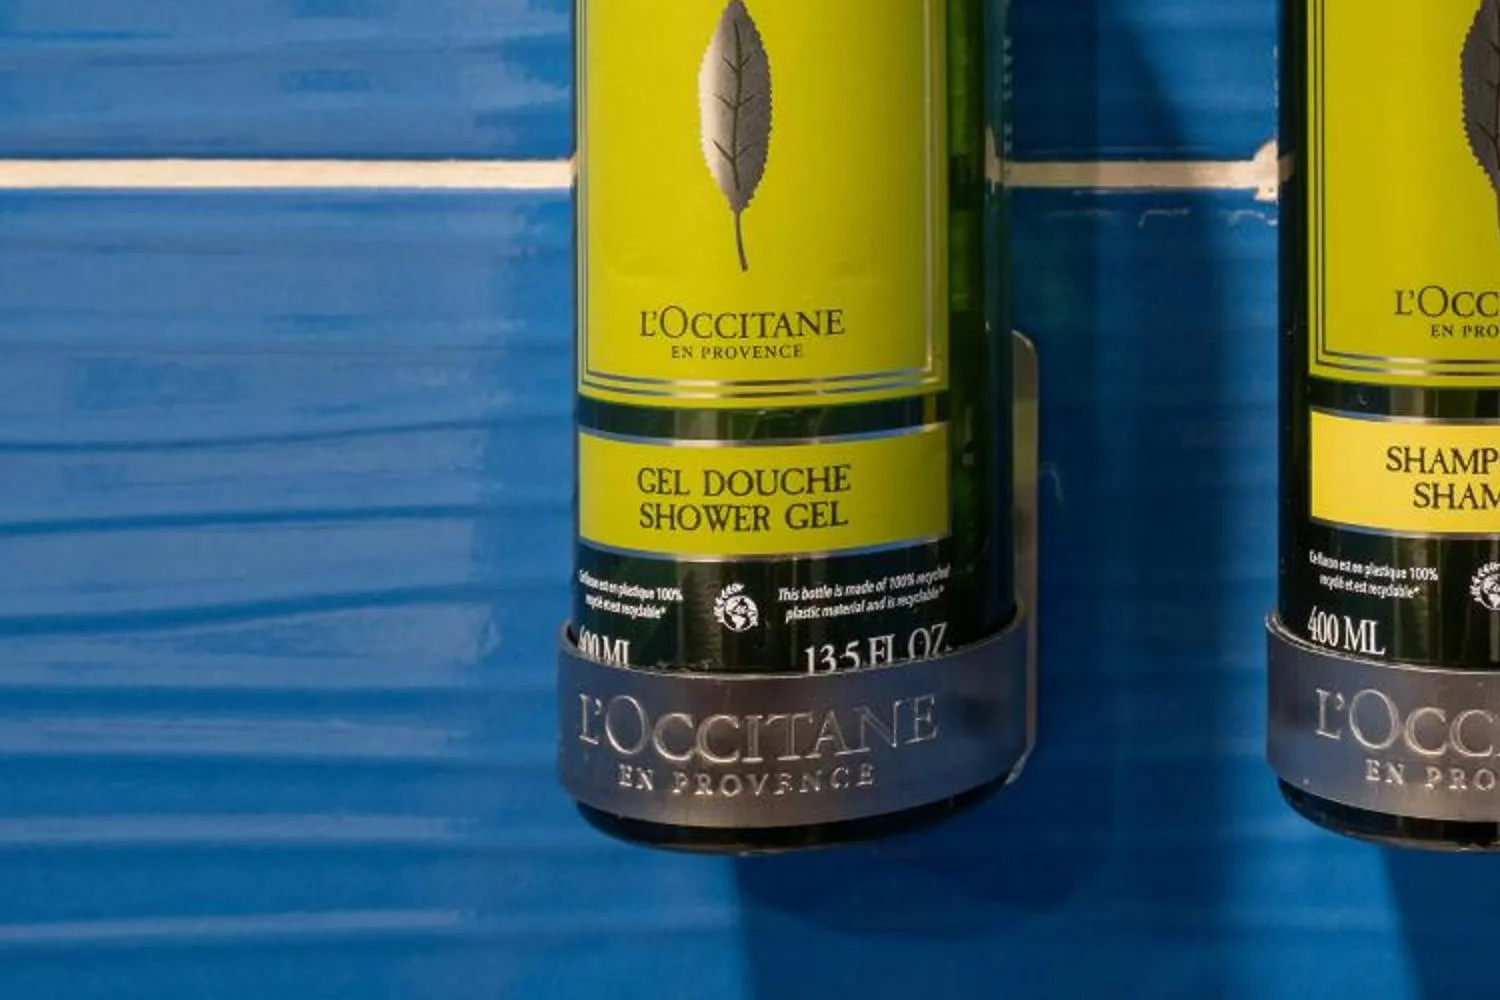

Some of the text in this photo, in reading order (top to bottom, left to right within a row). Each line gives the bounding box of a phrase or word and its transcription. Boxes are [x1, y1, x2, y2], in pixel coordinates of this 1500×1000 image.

[640, 305, 845, 339] L'OCCITANE
[1430, 323, 1454, 338] EN
[671, 343, 804, 360] EN PROVENCE
[637, 463, 851, 497] GEL DOUCHE
[640, 501, 849, 532] SHOWER GEL
[778, 586, 800, 601] This
[801, 584, 833, 600] bottle
[834, 583, 843, 597] is
[845, 579, 875, 597] made
[876, 576, 887, 592] of
[1409, 567, 1439, 581] 100%
[656, 587, 684, 601] 100%
[784, 605, 820, 624] plastic
[821, 600, 865, 617] material
[866, 595, 887, 612] and
[1308, 605, 1386, 655] 400 ML
[578, 692, 940, 764] L'OCCITANE
[618, 763, 874, 797] EN PROVENCE
[1364, 758, 1405, 786] EN
